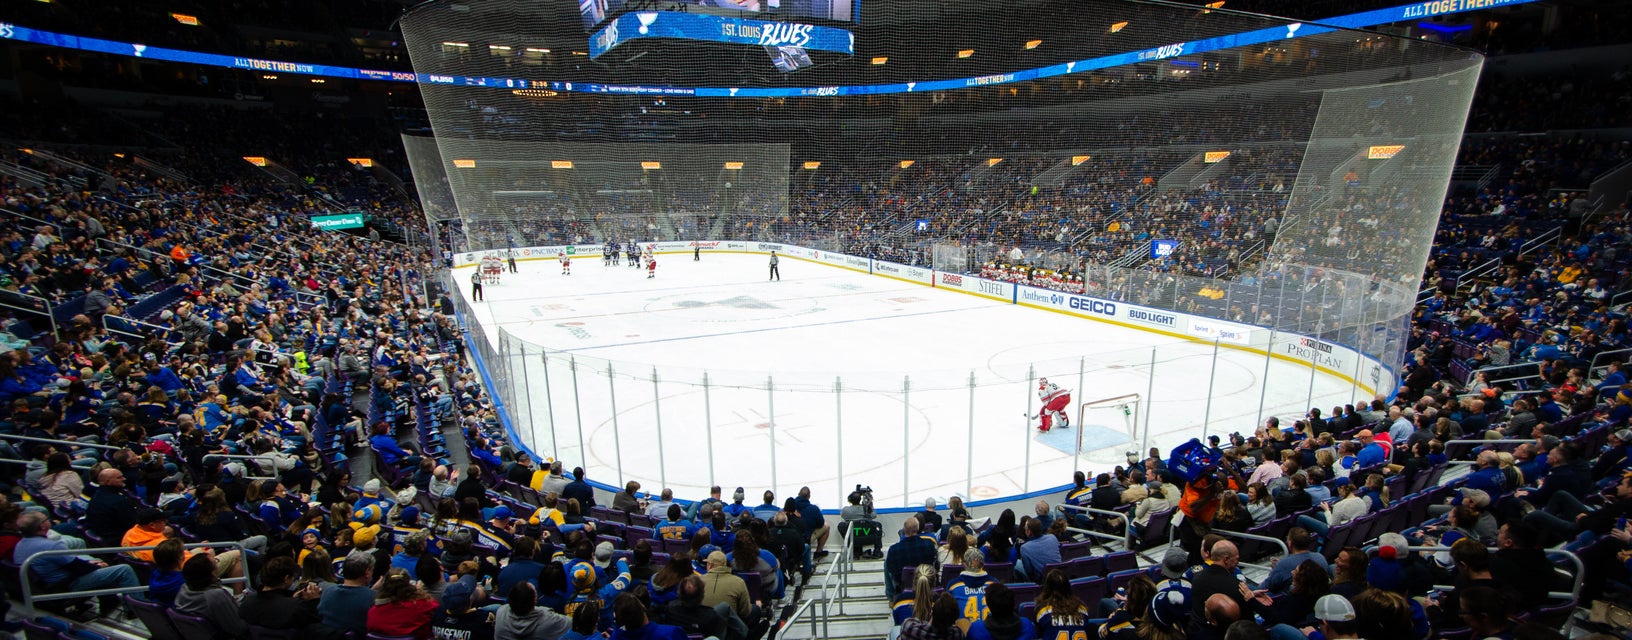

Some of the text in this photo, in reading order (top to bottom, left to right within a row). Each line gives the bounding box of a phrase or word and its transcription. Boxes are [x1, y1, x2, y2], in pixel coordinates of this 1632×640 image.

[1402, 0, 1521, 18] ALLTOGETHER
[725, 24, 737, 36] ST.
[738, 25, 760, 38] LOUIS
[758, 22, 813, 46] BLUES
[1155, 43, 1185, 59] BLUES
[392, 72, 415, 81] 50/50
[943, 274, 963, 284] DOBBS
[979, 279, 1004, 296] STIFEL
[1022, 289, 1049, 303] Anthem
[1069, 296, 1116, 316] GEICO
[1129, 309, 1175, 325] BUD LIGHT
[1194, 325, 1235, 339] Sprint Sprint
[853, 527, 871, 536] TV
[964, 586, 988, 595] BACKE
